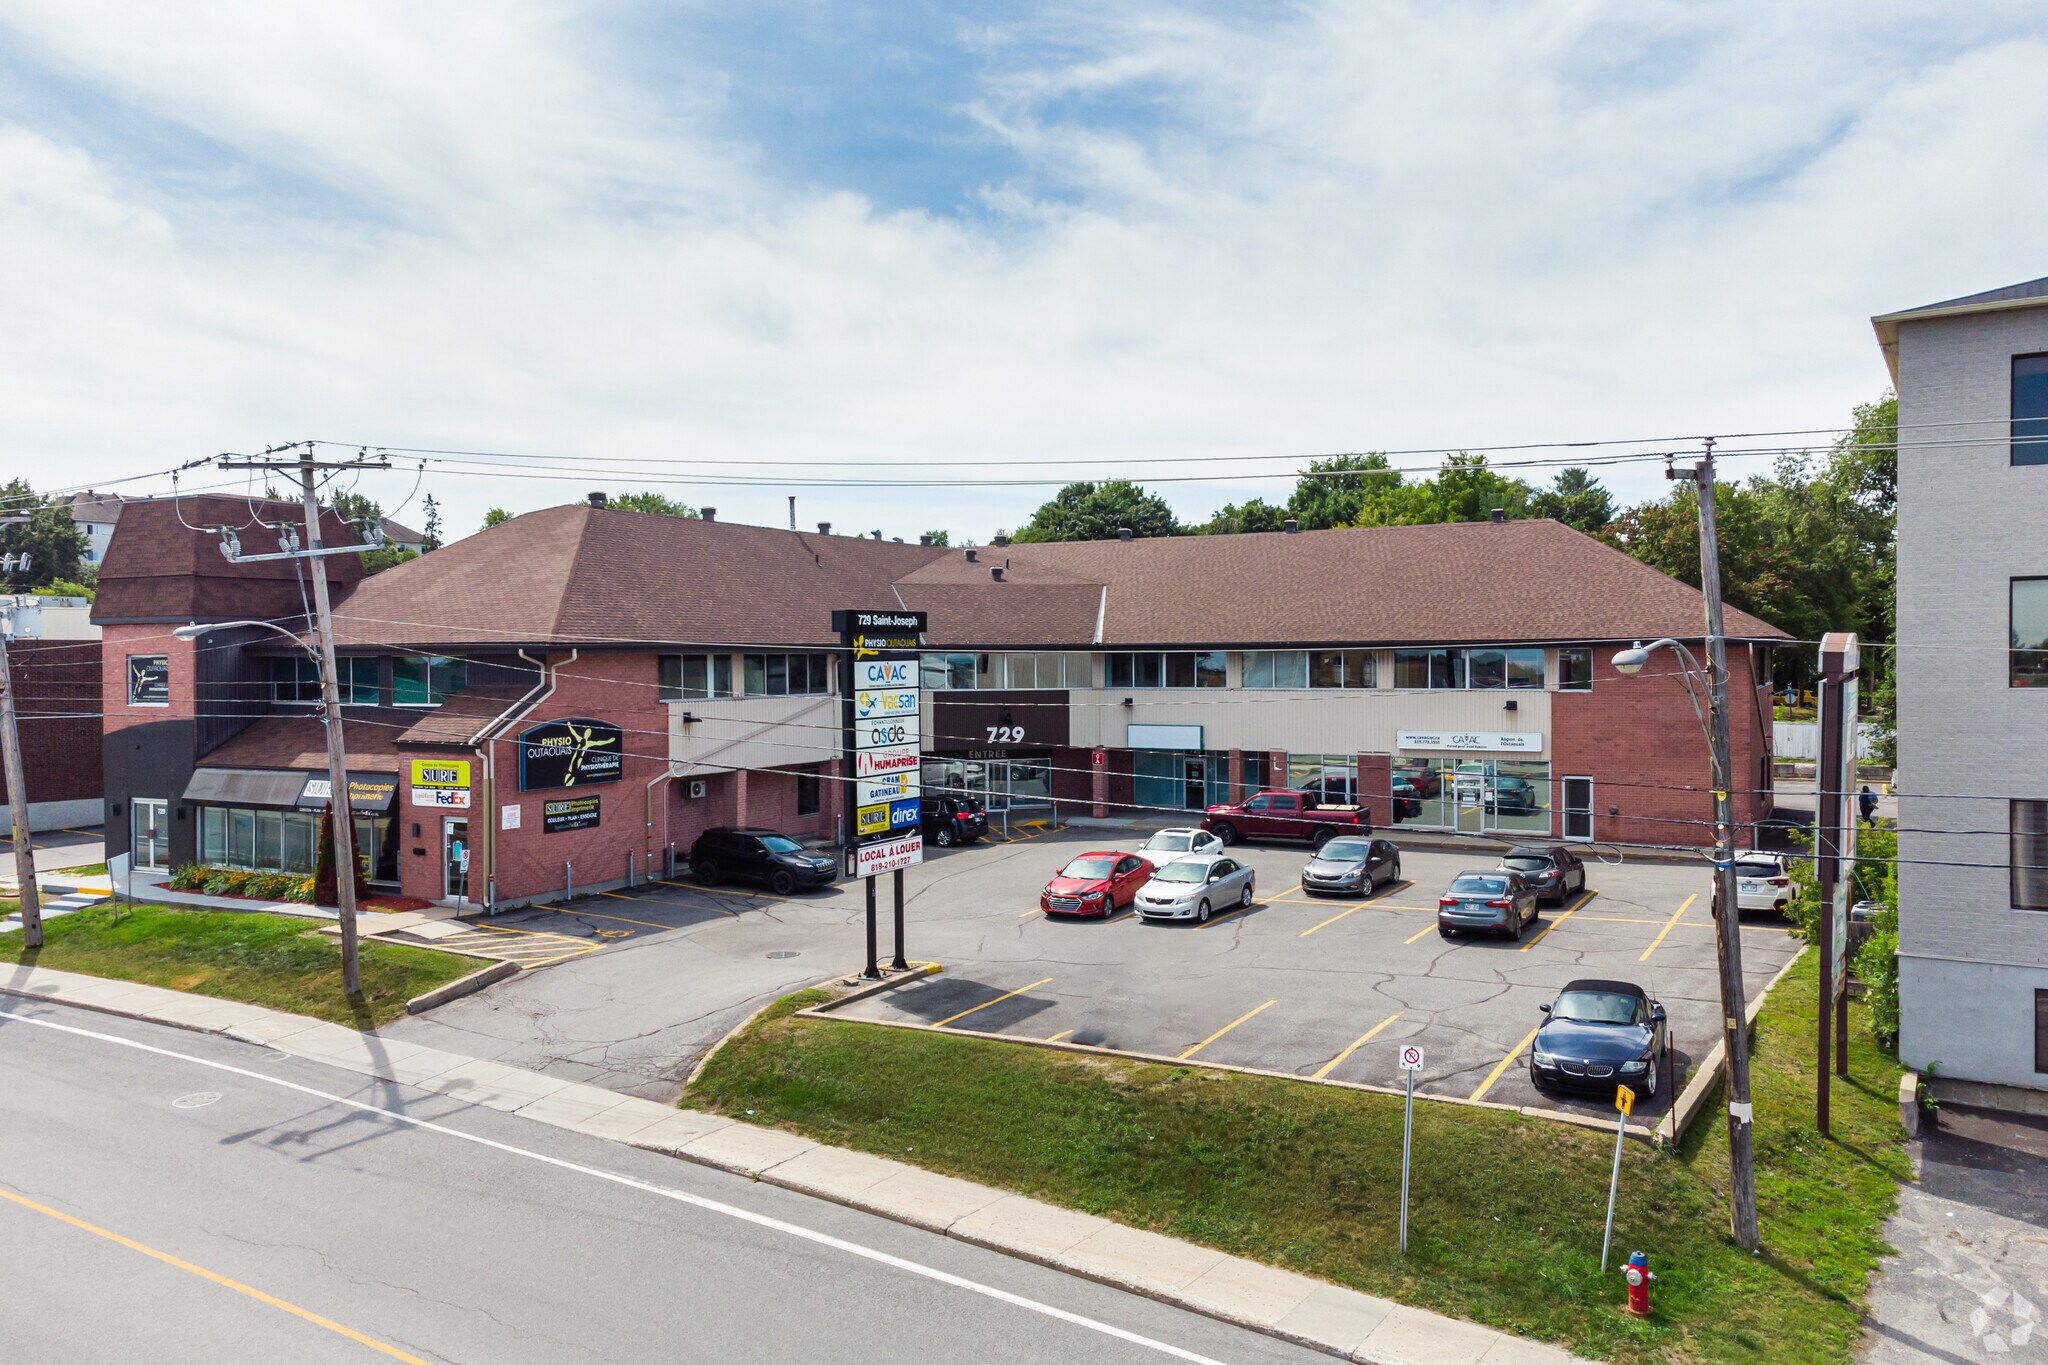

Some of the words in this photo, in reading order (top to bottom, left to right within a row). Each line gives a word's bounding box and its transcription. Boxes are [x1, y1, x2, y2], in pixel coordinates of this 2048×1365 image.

[858, 614, 871, 625] 729
[873, 614, 918, 628] Saint-Joseph
[867, 663, 907, 681] CAVAC
[871, 724, 905, 744] asde
[986, 726, 1025, 744] 729
[1452, 735, 1480, 744] CAVAC
[541, 736, 572, 747] PHYSIO
[528, 746, 572, 758] OUTAOUAIS
[591, 755, 612, 763] CLINIQUE
[874, 756, 918, 771] HUMAPRISE
[423, 769, 458, 782] SURE
[348, 781, 395, 792] Photocopies
[869, 786, 900, 798] GATINEAU
[436, 791, 466, 805] FedEx
[861, 810, 886, 826] SURE
[860, 848, 886, 863] LOCAL
[896, 841, 921, 856] LOUER
[871, 856, 911, 872] 819-210-1727
